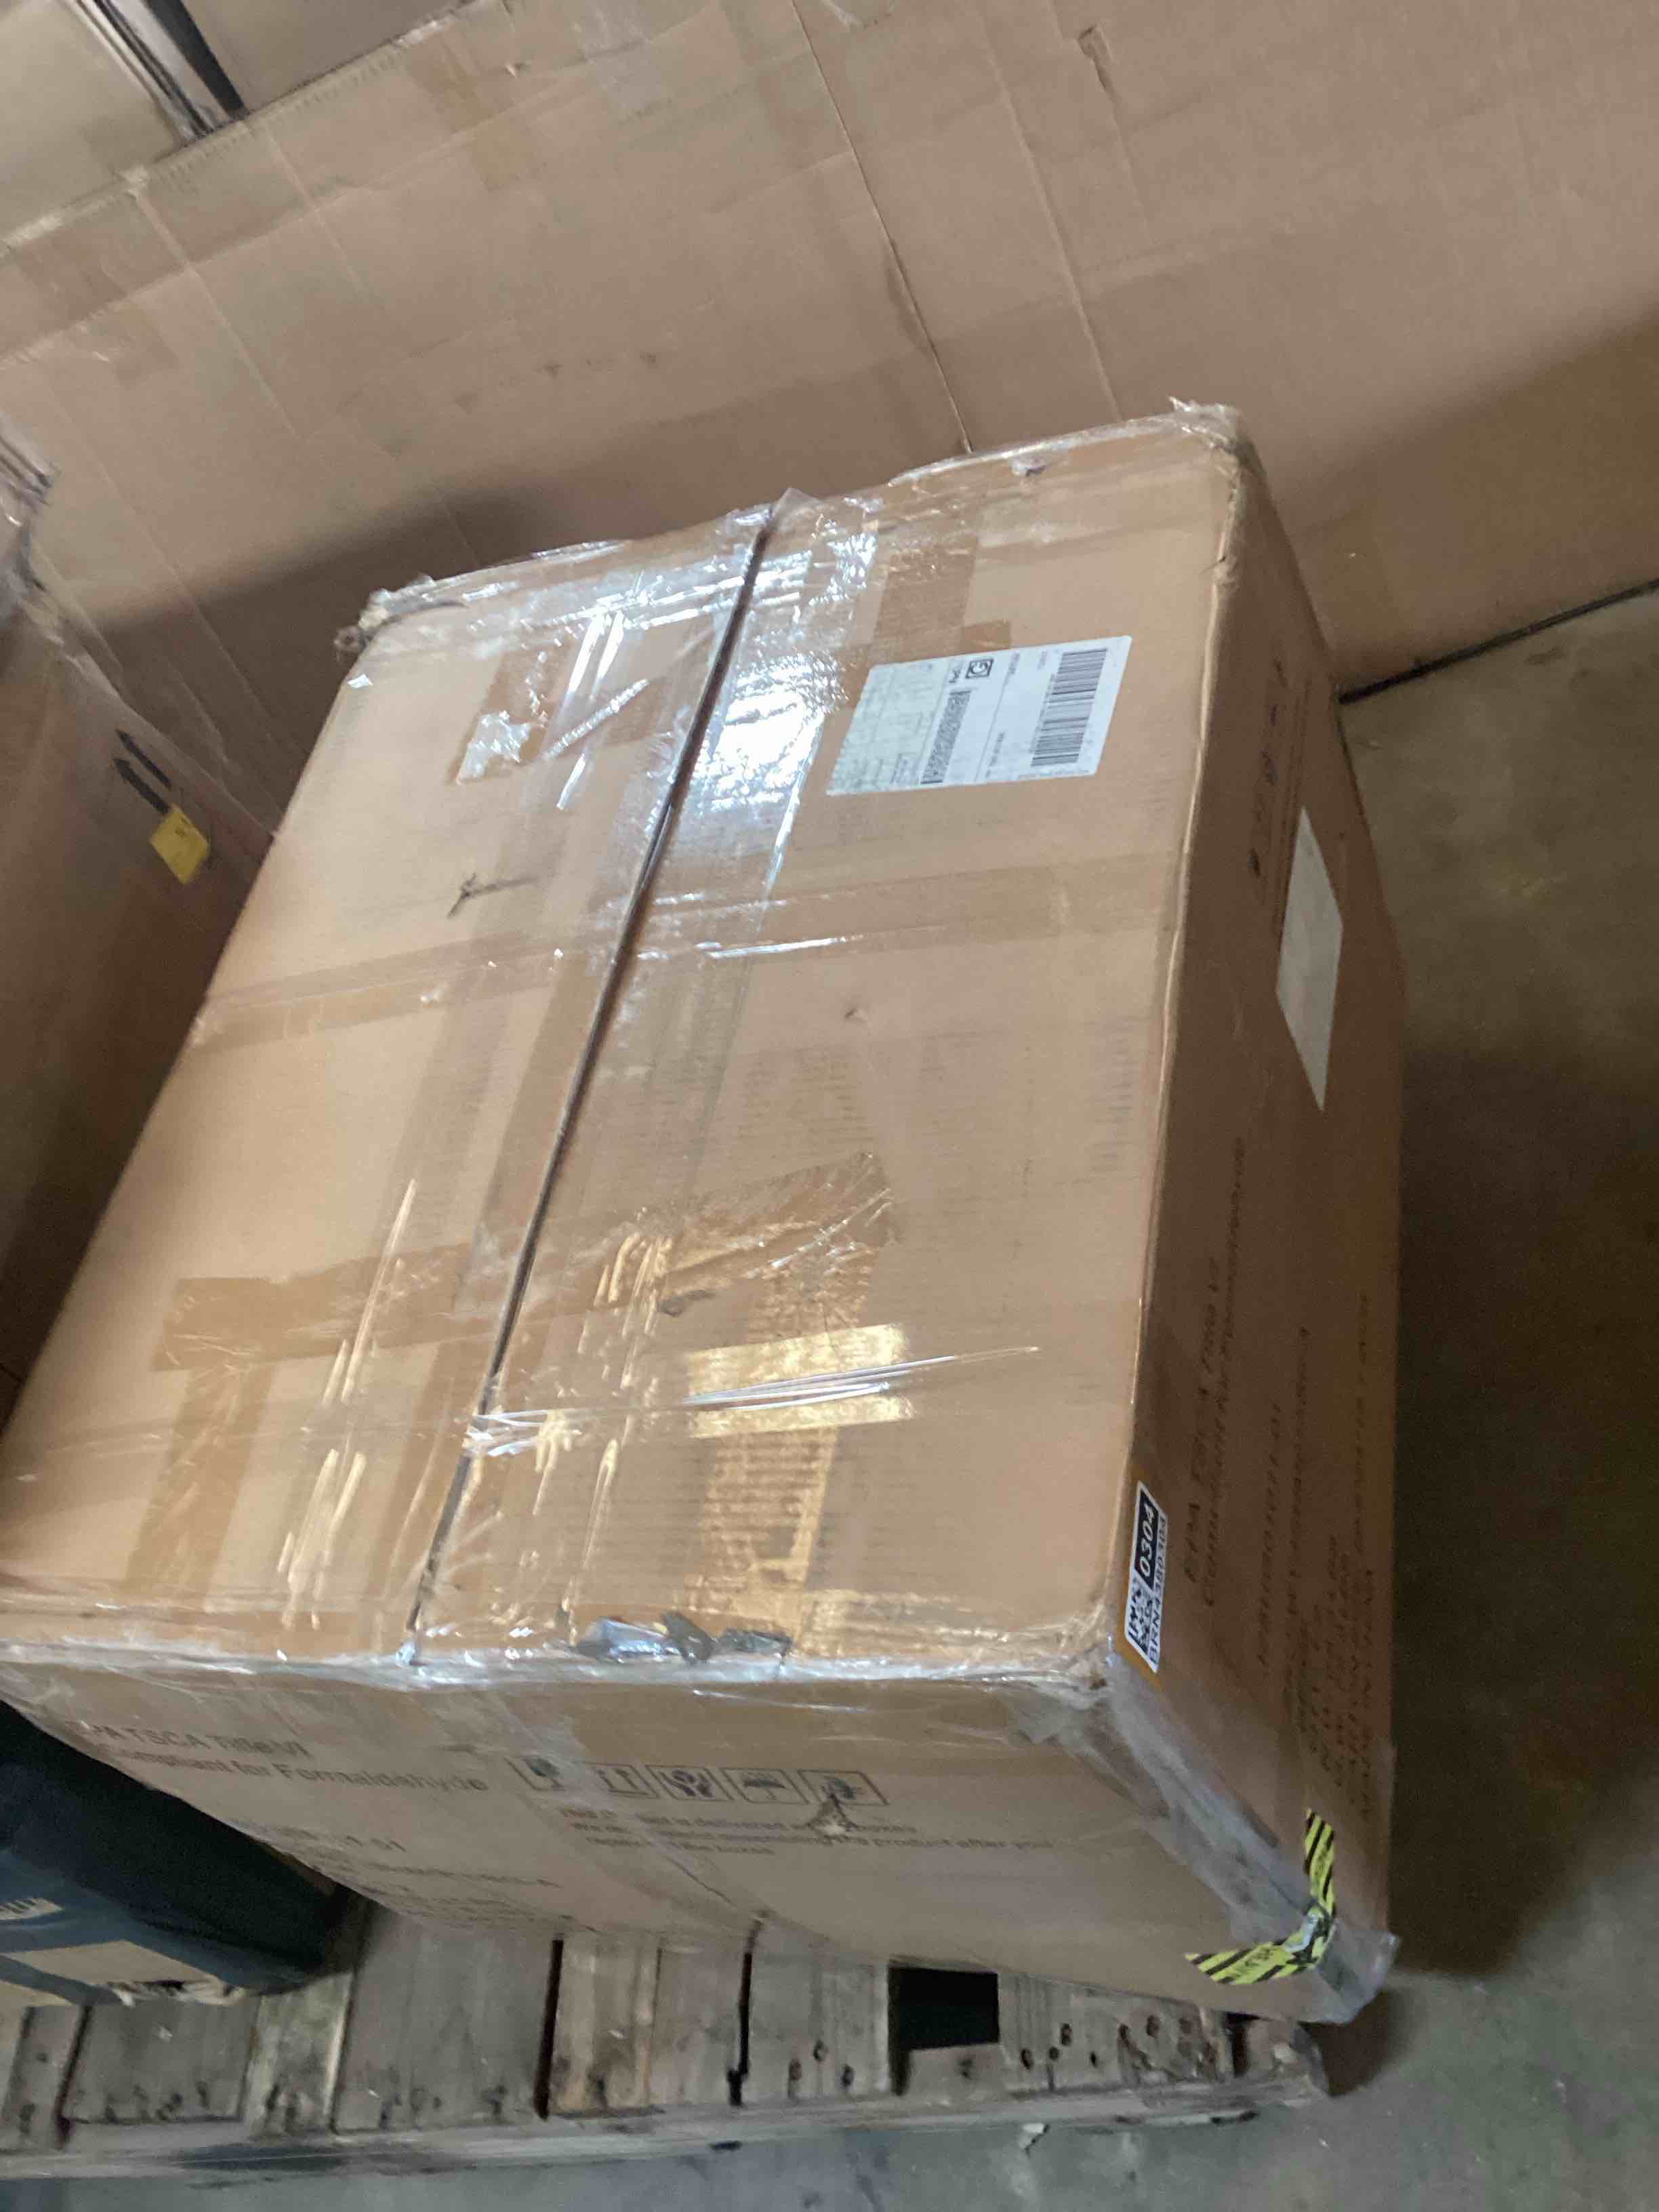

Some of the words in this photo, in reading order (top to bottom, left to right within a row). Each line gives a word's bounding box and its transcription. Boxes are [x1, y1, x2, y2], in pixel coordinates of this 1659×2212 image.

[1139, 1501, 1155, 1578] 0304
[121, 1727, 211, 1750] TSCA
[205, 1734, 273, 1754] Title
[270, 1762, 489, 1792] Formaldehyde
